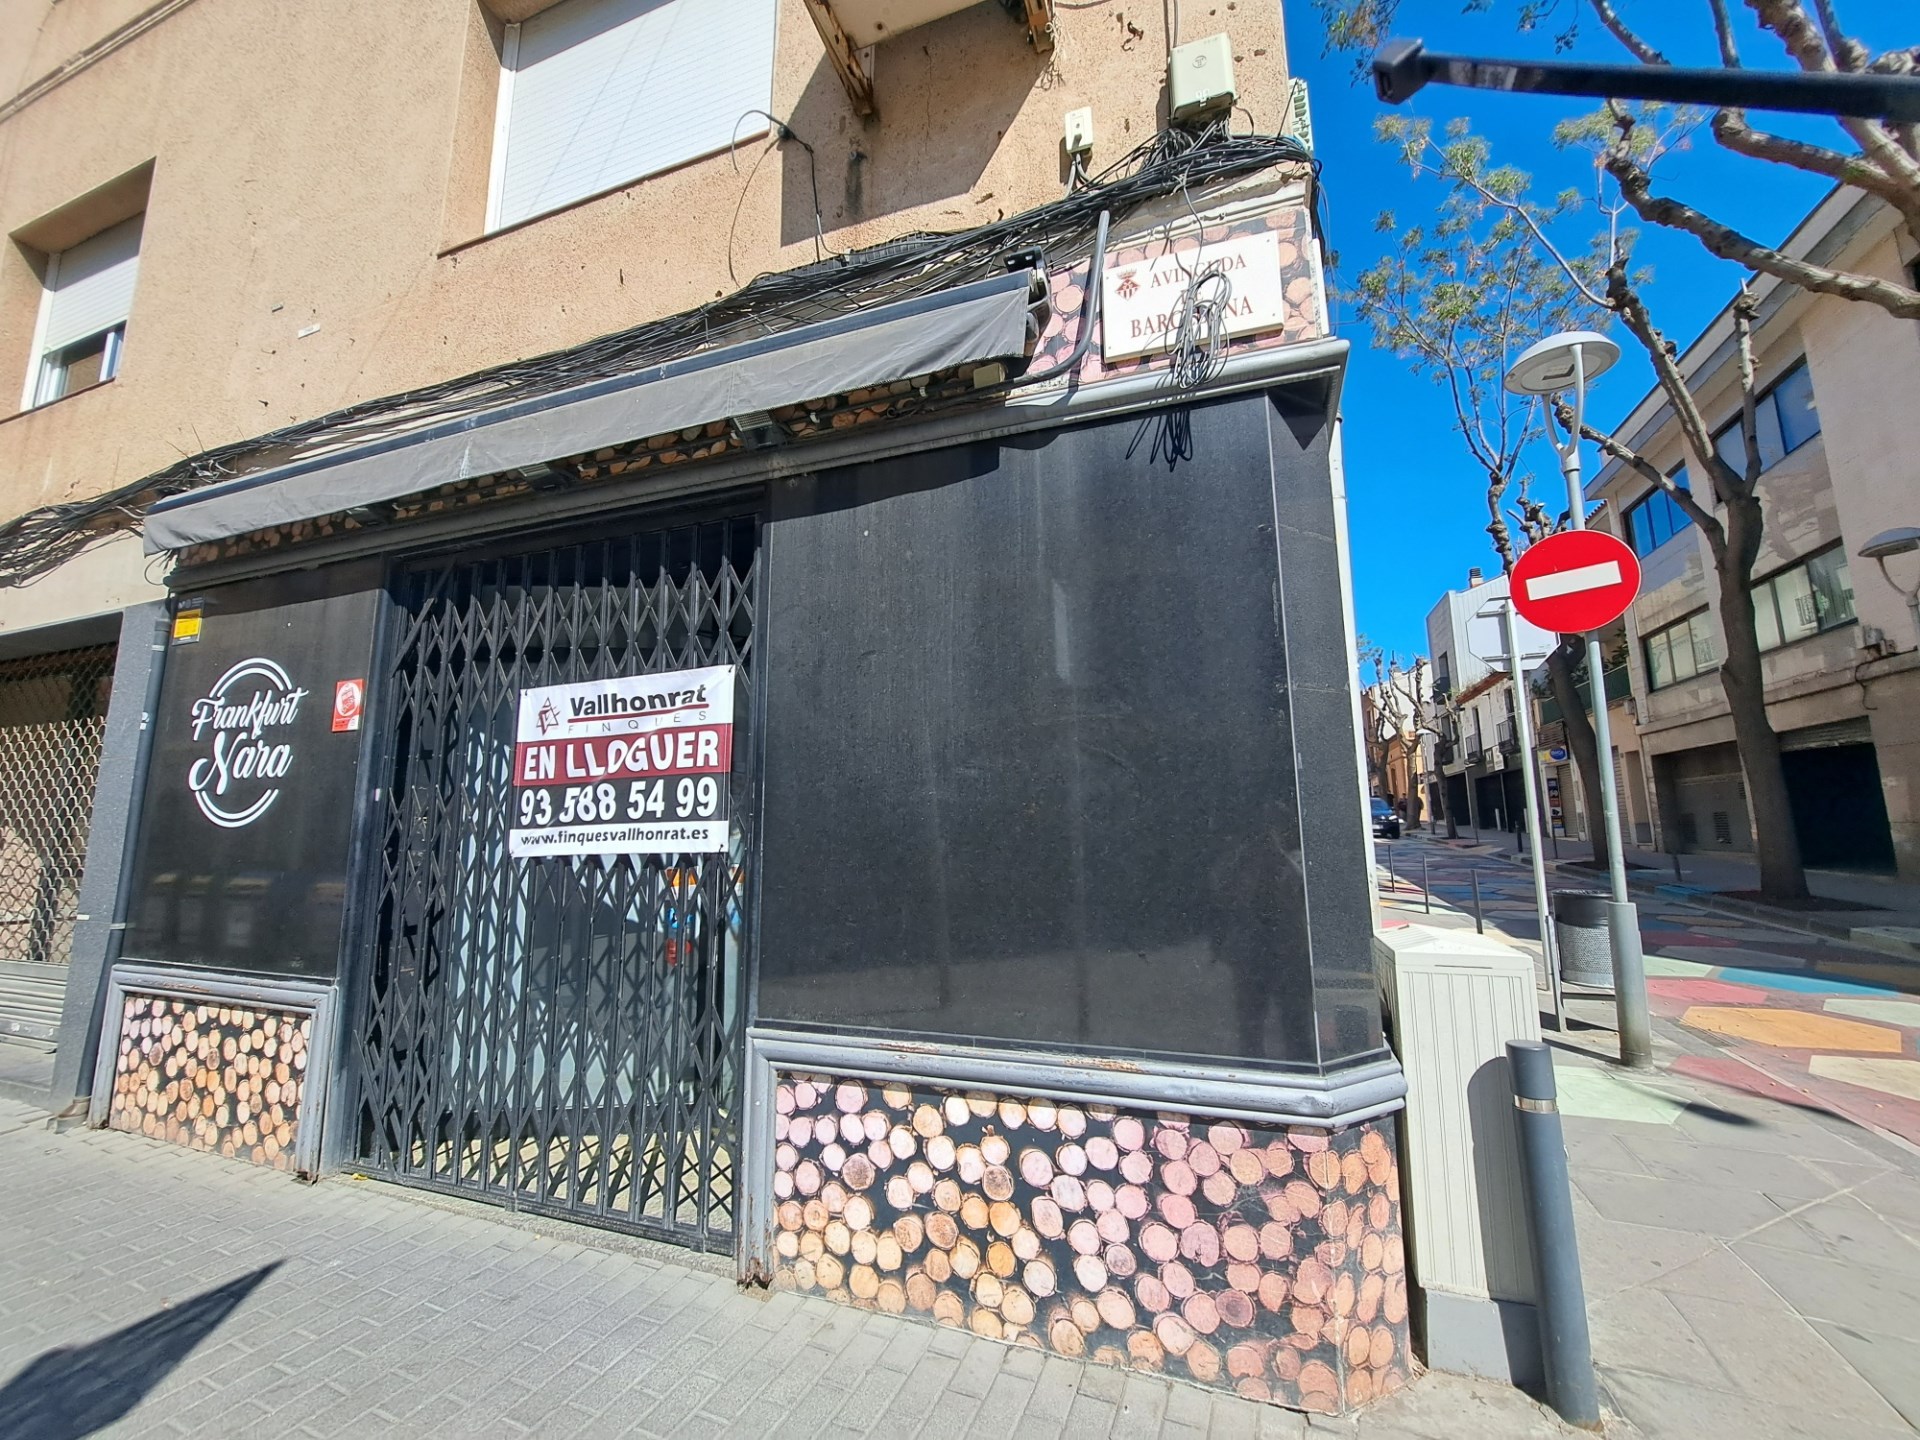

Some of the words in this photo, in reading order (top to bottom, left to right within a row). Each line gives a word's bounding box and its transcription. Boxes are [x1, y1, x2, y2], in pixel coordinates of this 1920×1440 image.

[192, 688, 308, 741] Frankfurt
[570, 684, 706, 716] Vallhonrat
[568, 711, 706, 733] FINQUES
[523, 745, 556, 780] EN
[566, 730, 719, 778] LLOGUER
[520, 788, 552, 826] 93
[627, 779, 665, 819] 54
[676, 777, 718, 817] 99
[521, 828, 709, 847] www.finquesvallhonrat.es
